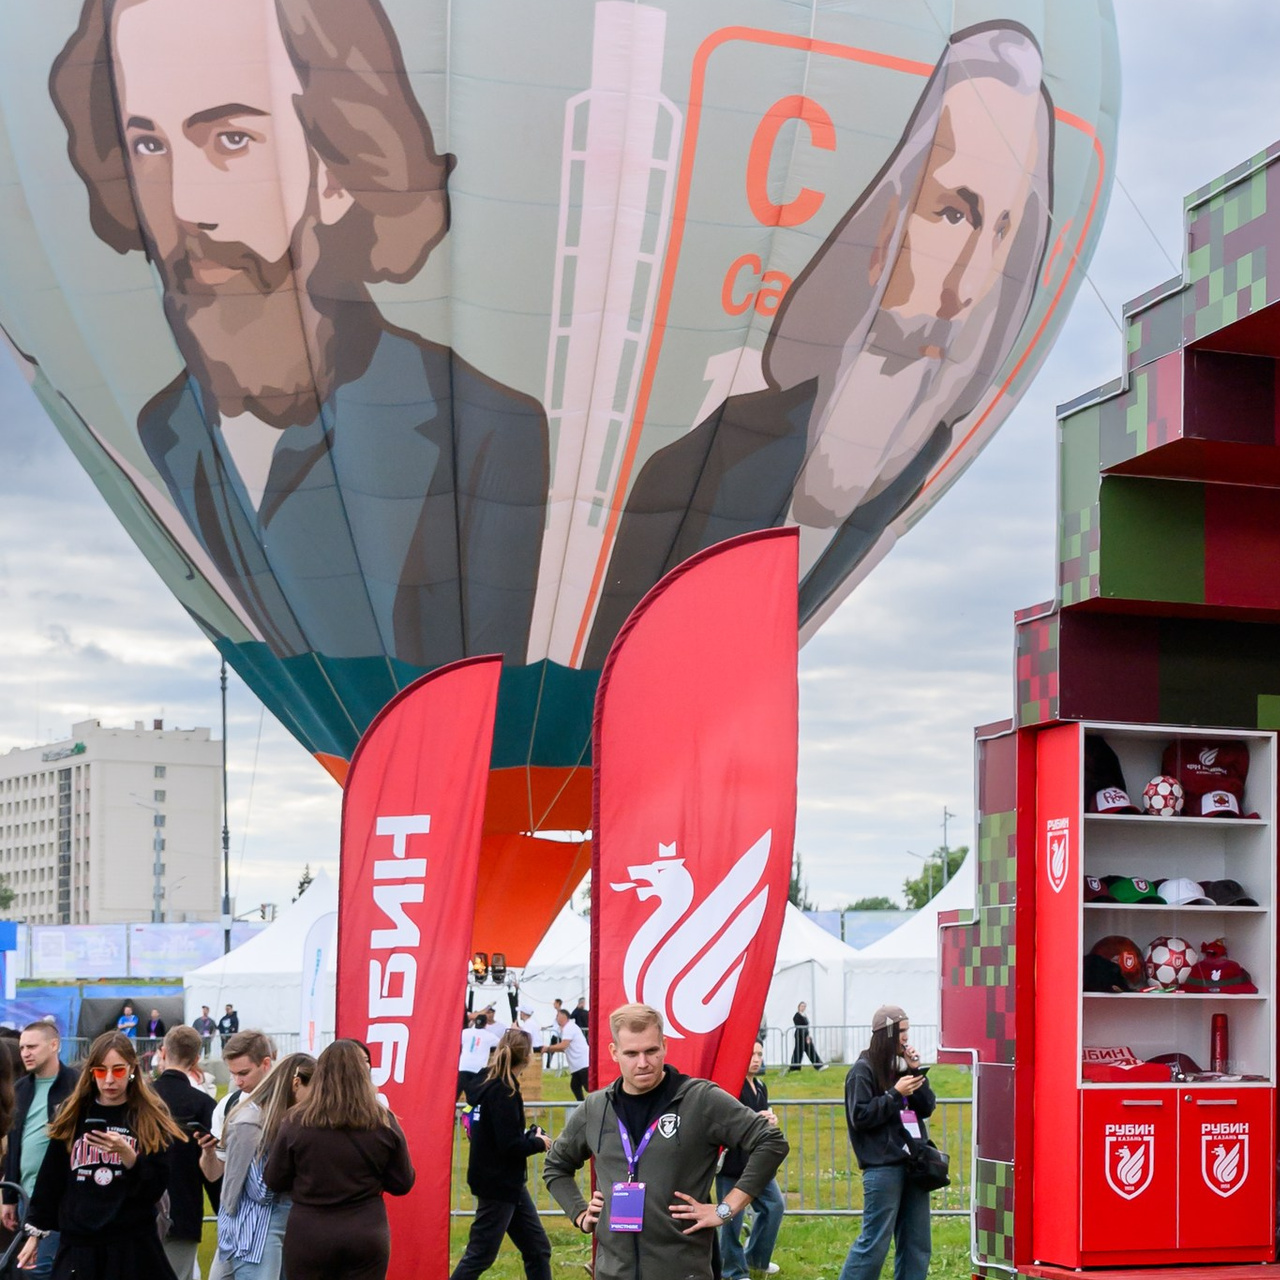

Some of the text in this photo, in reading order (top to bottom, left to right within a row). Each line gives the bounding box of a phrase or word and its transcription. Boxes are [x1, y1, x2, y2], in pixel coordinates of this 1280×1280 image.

[366, 815, 431, 1110] УБИН
[1105, 1123, 1155, 1136] РУБИН
[1201, 1122, 1249, 1135] РУБИН
